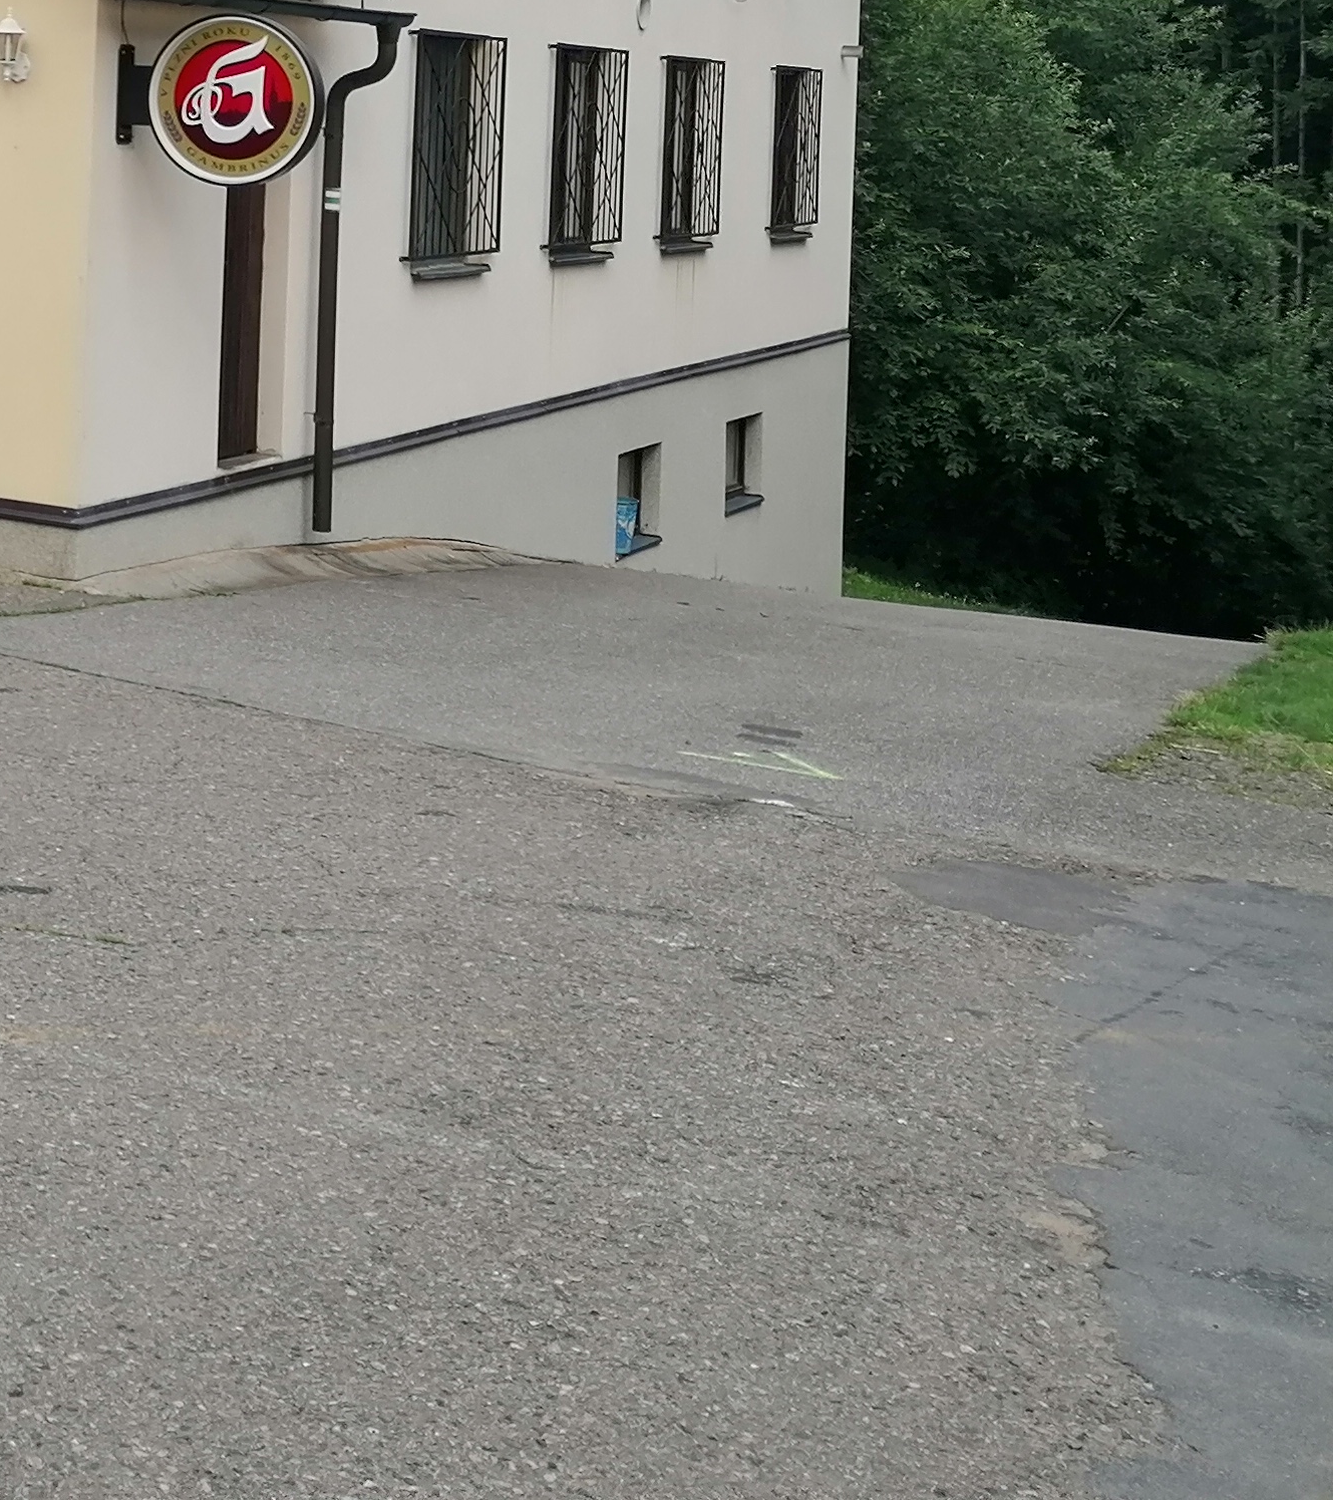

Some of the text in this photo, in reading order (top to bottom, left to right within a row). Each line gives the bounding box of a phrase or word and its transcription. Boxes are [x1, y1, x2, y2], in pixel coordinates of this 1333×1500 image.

[202, 27, 250, 40] ROKU
[274, 45, 301, 80] 1869
[186, 143, 289, 173] GAMBRINUS
